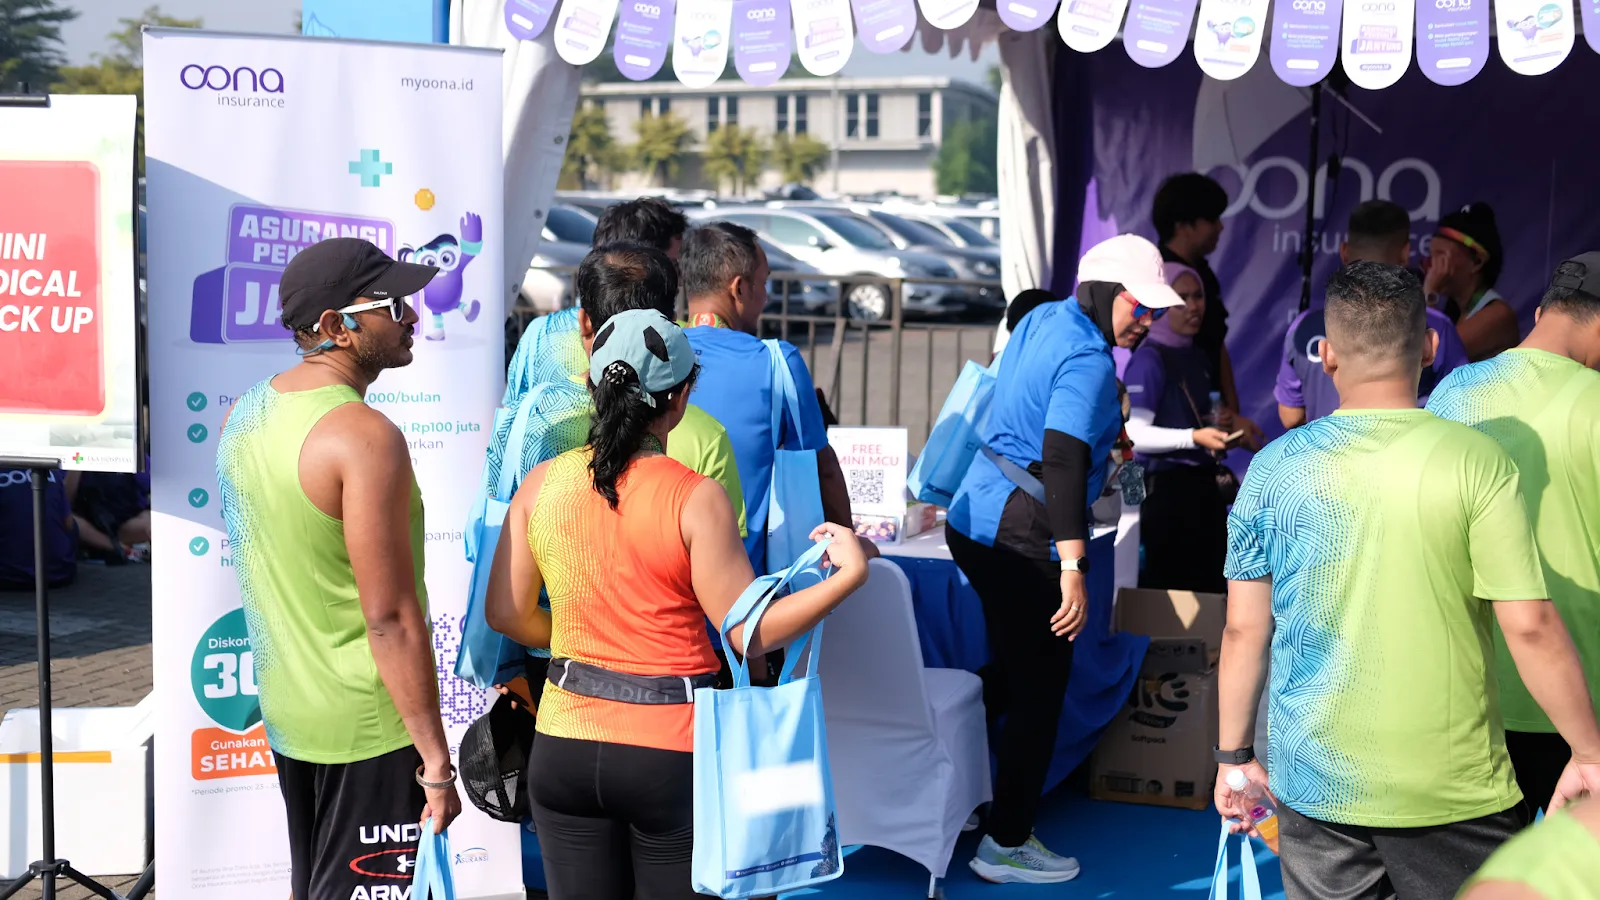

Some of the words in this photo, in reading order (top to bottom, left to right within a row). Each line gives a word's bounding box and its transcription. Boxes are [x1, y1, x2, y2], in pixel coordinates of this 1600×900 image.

[180, 63, 285, 93] oona
[400, 76, 474, 92] myoona.id
[217, 92, 285, 108] insurance
[239, 213, 387, 250] ASURANSI
[0, 232, 47, 260] INI
[50, 305, 94, 334] UP
[411, 422, 453, 435] Rp100
[456, 421, 480, 435] juta
[852, 444, 883, 455] FREE
[839, 455, 865, 466] MINI
[869, 456, 899, 466] MCU
[208, 636, 252, 649] Diskon
[210, 738, 265, 751] Gunakan
[200, 751, 276, 773] SEHAT
[225, 784, 253, 794] promo:
[359, 823, 420, 844] UND
